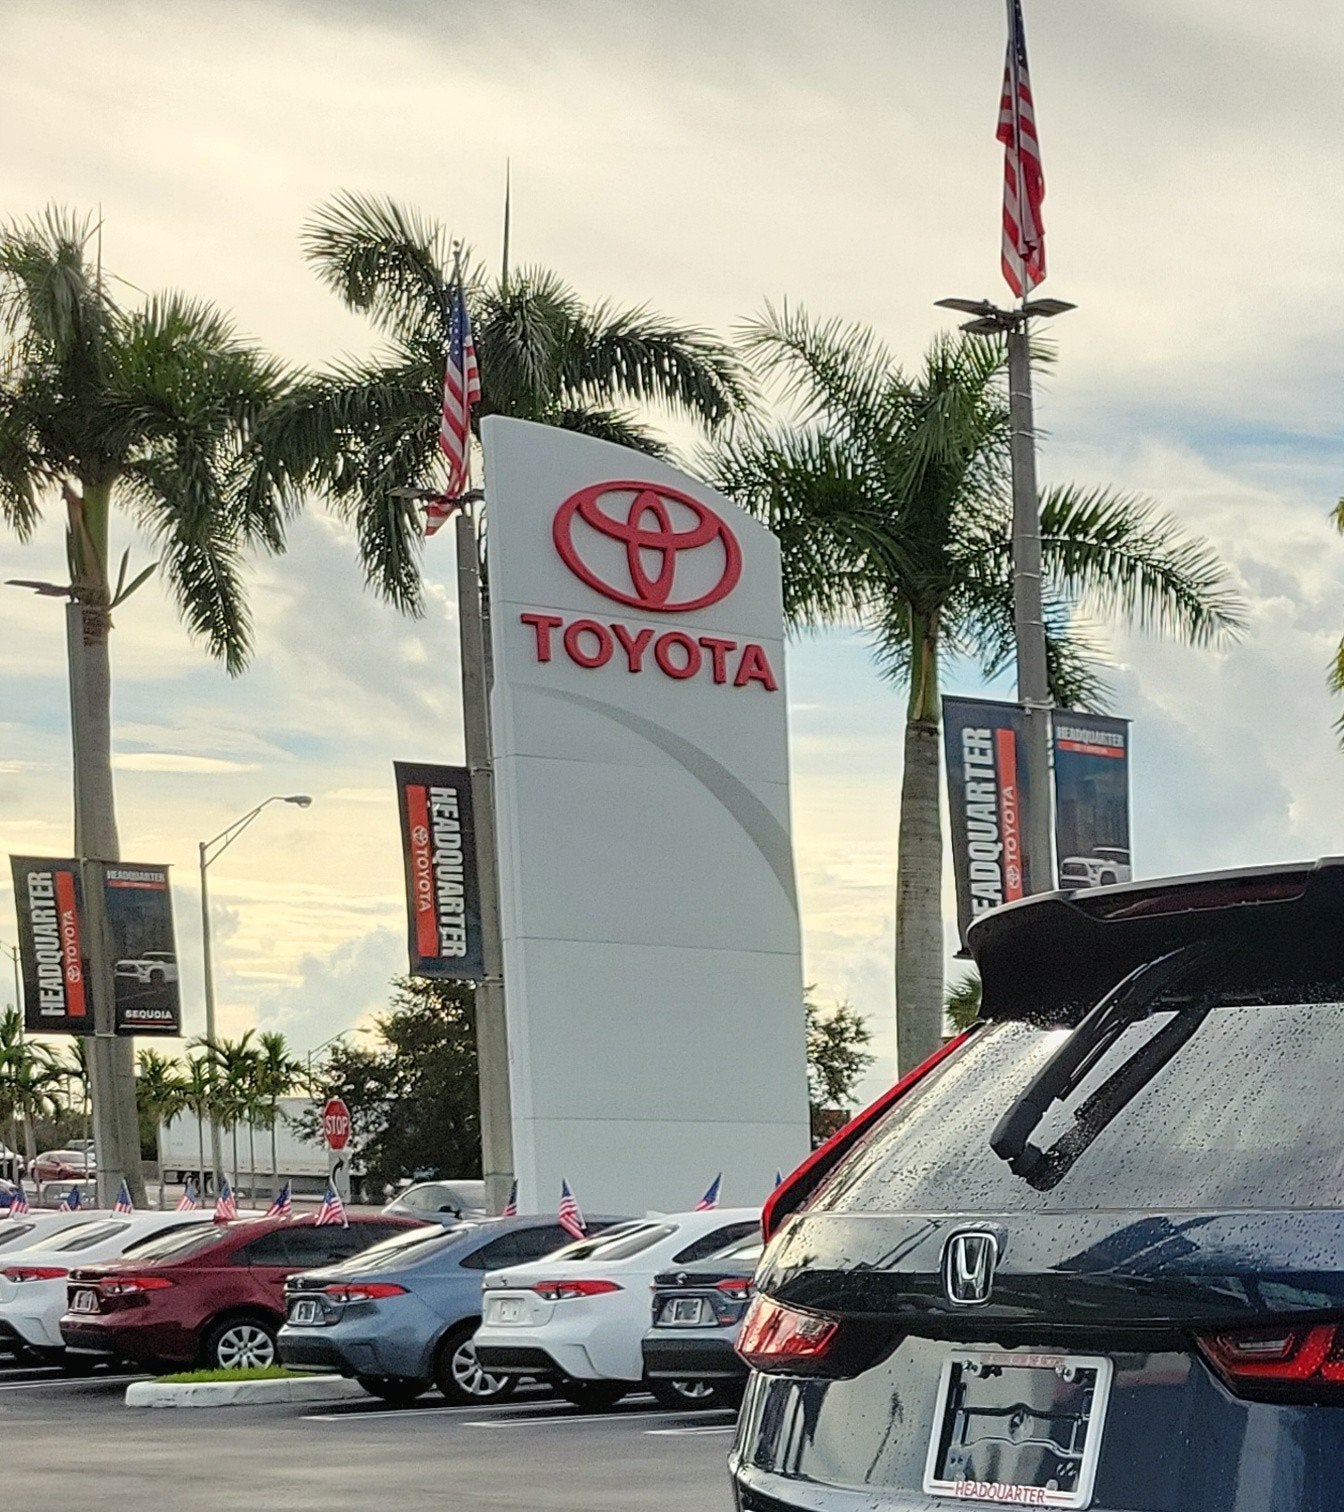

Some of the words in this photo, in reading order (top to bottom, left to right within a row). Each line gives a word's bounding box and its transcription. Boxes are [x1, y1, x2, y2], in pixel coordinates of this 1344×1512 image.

[520, 613, 779, 692] TOYOTA
[962, 728, 1003, 920] EADQUARTER
[1003, 786, 1018, 864] TOYOTA
[415, 850, 432, 912] TOYOTA
[430, 786, 468, 958] HEADQUARTER
[28, 871, 66, 1017] HEADQUARTER
[63, 910, 80, 965] TOYOTA
[125, 1009, 173, 1020] SEQUOIA
[326, 1115, 348, 1136] STOP
[955, 1481, 1046, 1504] HEADQUARTER
